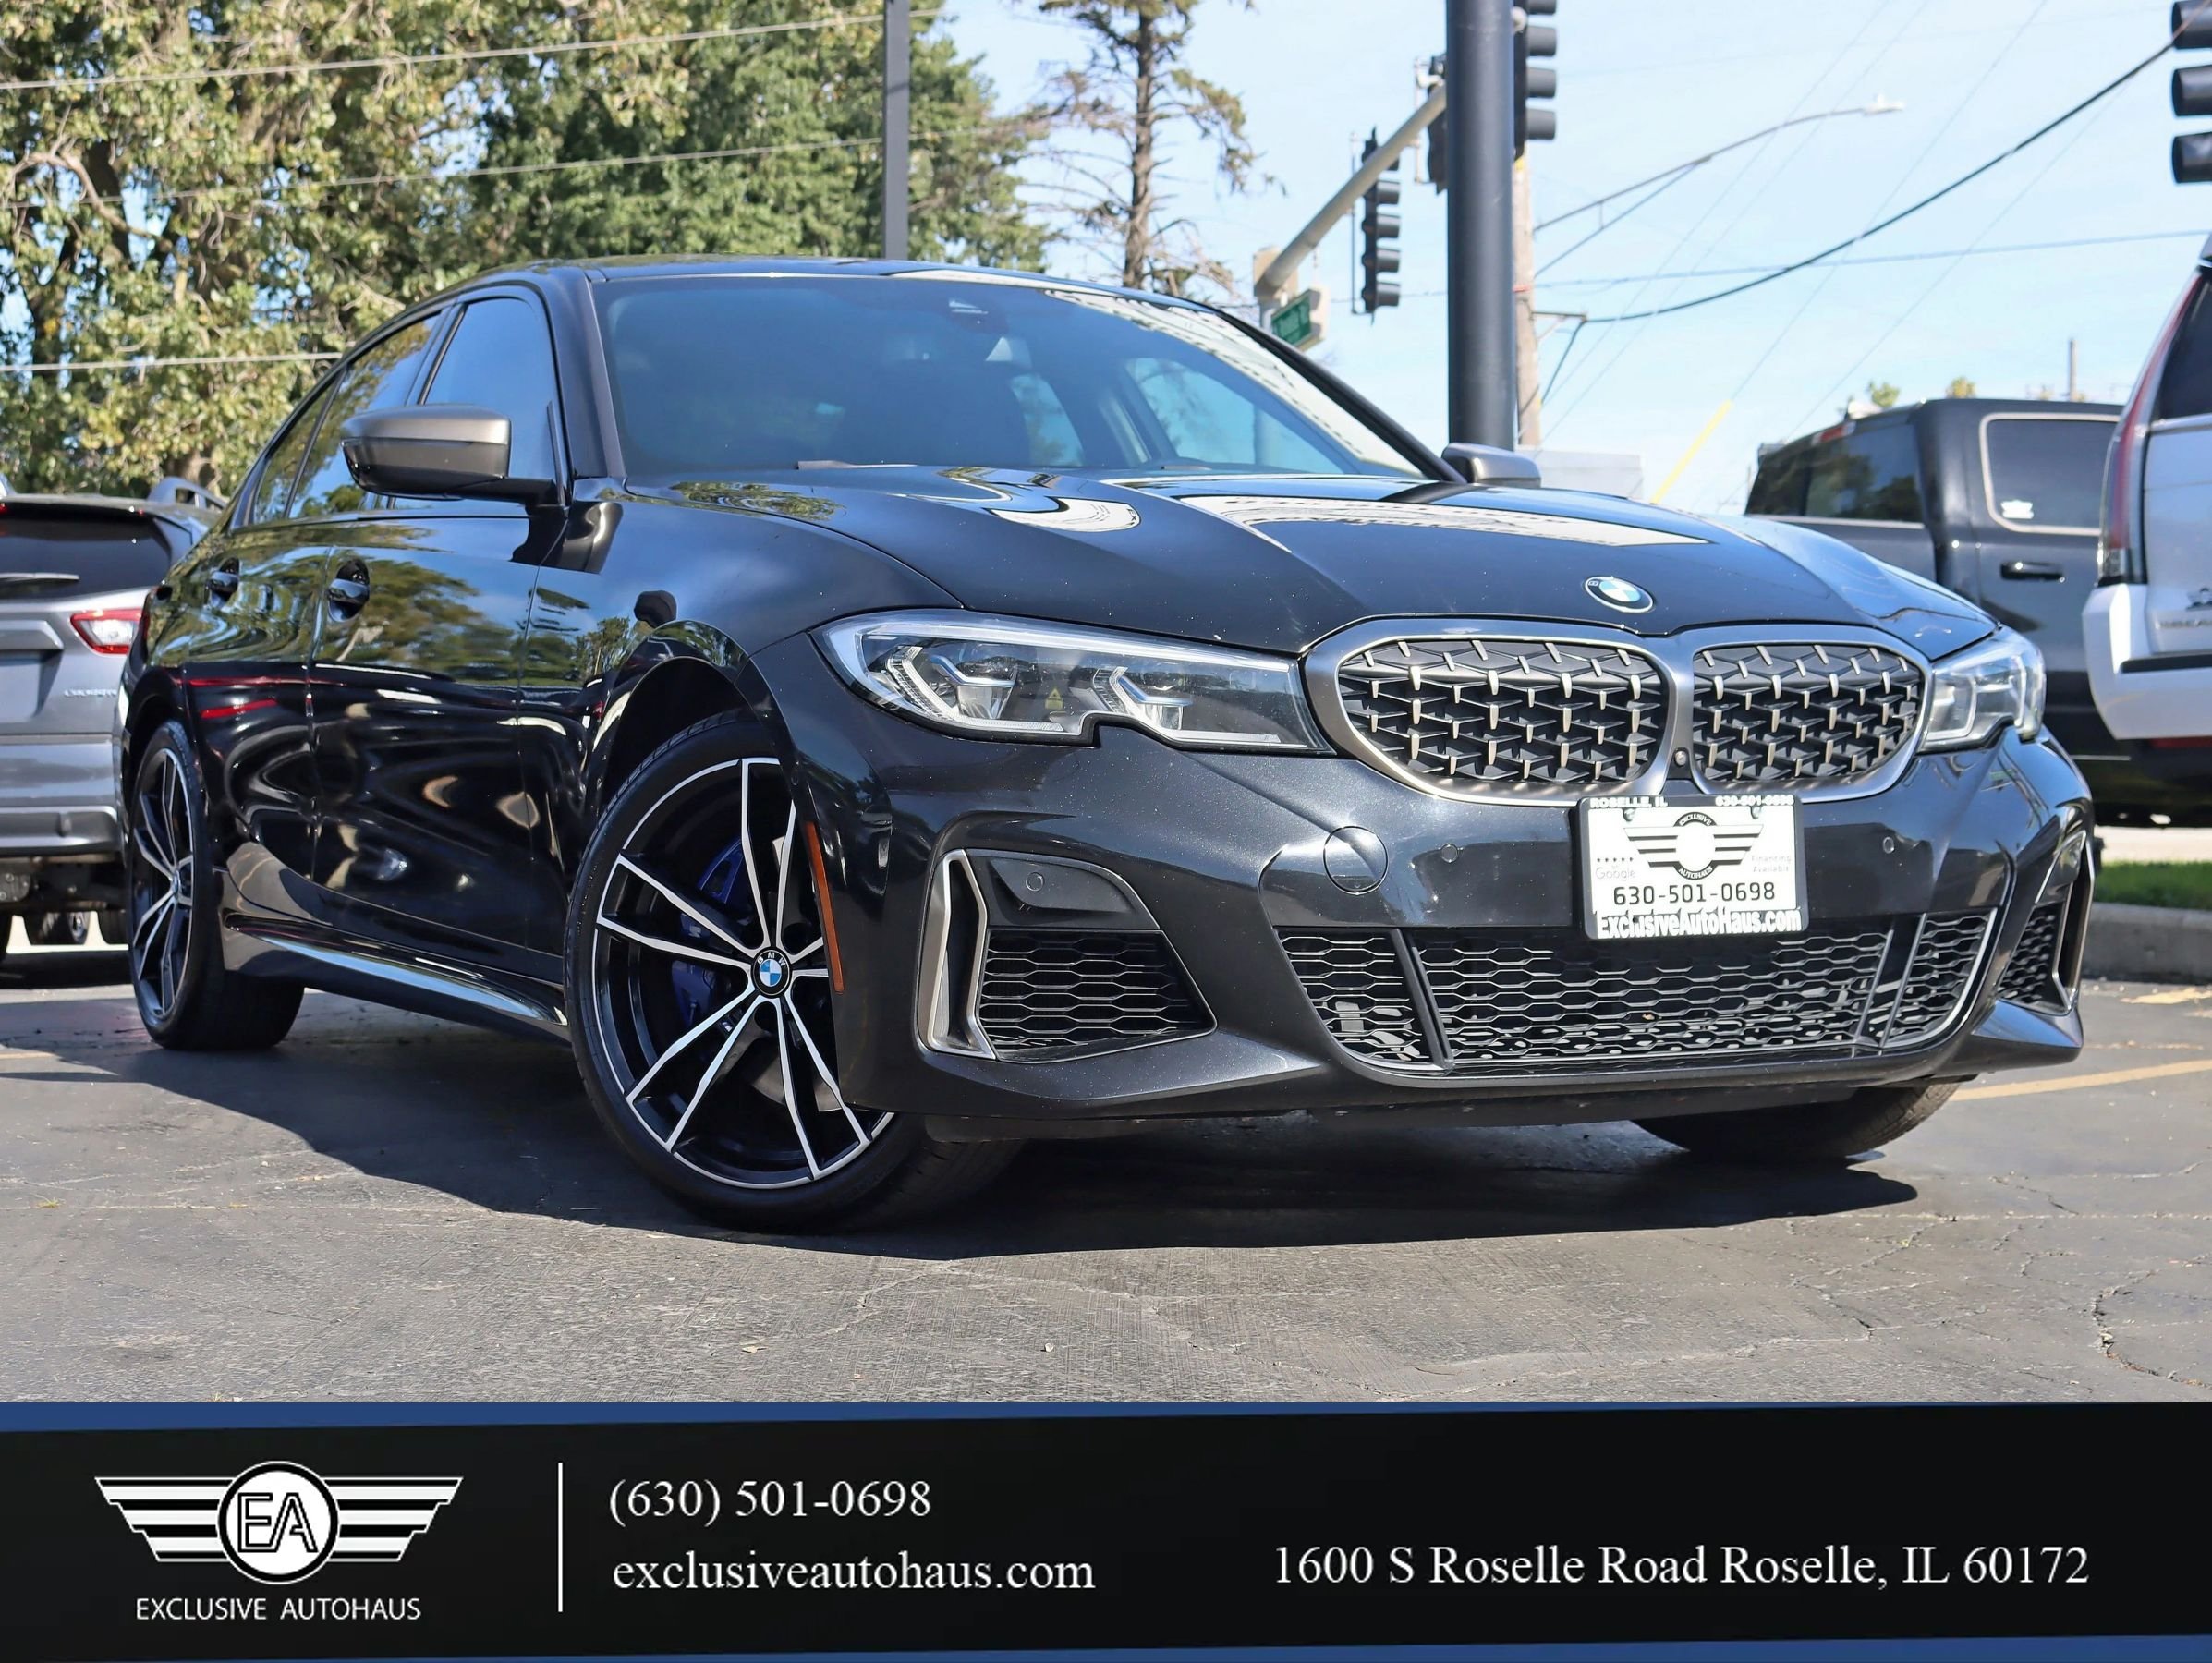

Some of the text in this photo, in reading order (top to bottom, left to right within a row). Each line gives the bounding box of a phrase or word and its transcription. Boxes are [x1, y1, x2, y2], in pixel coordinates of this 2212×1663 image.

[1590, 796, 1668, 808] ROSELLE, IL
[1596, 867, 1635, 881] Google
[1679, 866, 1713, 879] AUTOHAUS
[1613, 881, 1776, 906] 630-501-0698
[758, 952, 786, 967] BMW
